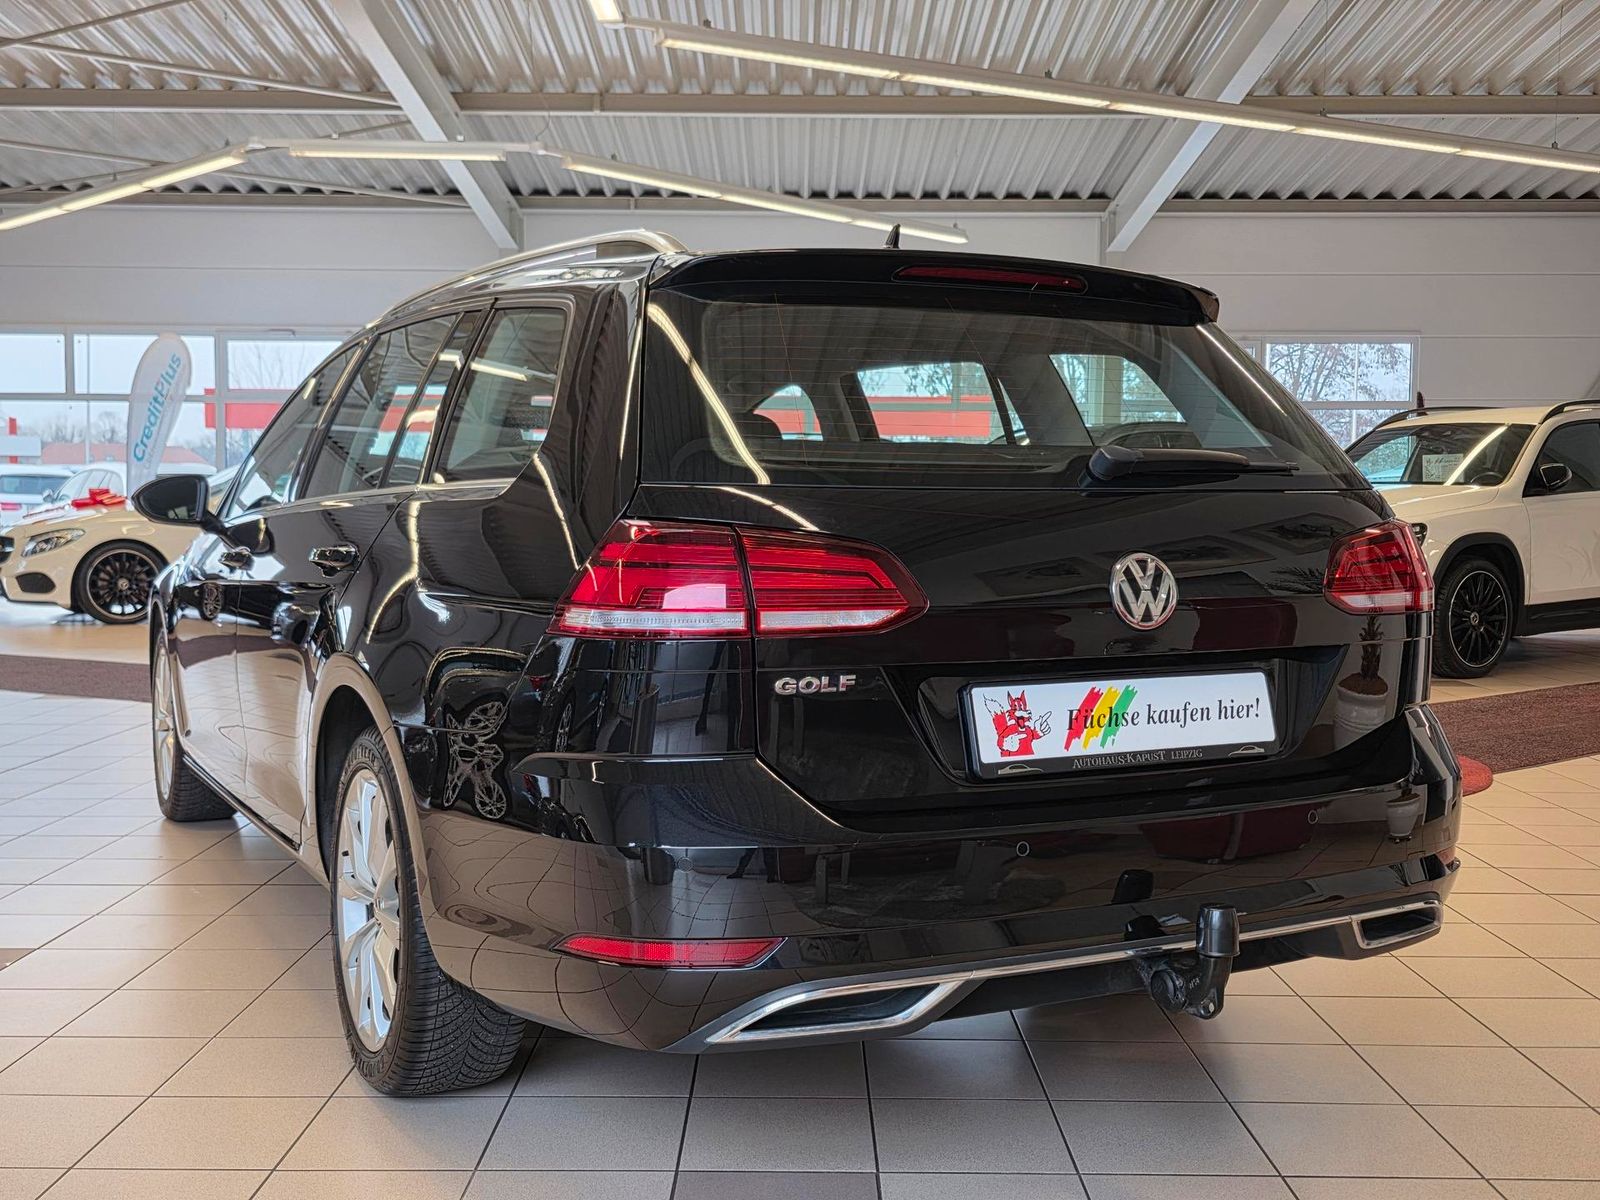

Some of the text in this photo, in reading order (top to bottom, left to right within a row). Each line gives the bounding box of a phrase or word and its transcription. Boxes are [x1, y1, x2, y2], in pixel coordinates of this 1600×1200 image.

[133, 353, 181, 462] CreditPlus
[1114, 554, 1175, 627] VW
[775, 674, 857, 695] GOLF
[1067, 697, 1260, 731] Füchse kaufen hier!
